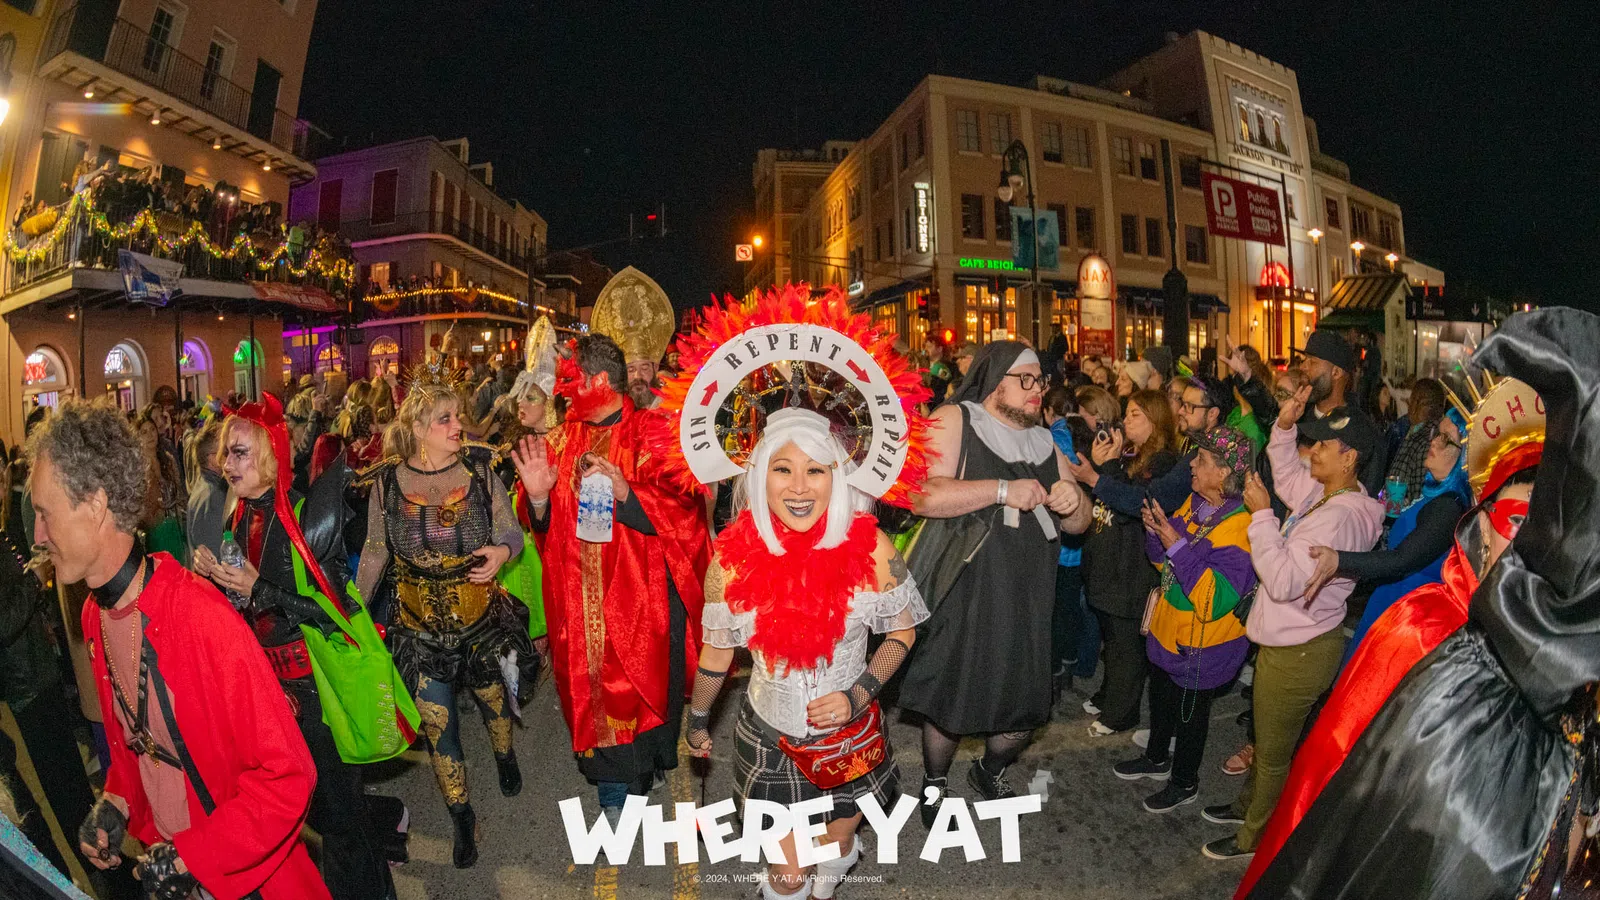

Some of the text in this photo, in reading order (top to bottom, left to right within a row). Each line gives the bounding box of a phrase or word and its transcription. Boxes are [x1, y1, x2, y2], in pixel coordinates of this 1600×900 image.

[1233, 144, 1265, 162] JACKSON
[1247, 189, 1269, 205] Public
[1249, 202, 1277, 220] Parking
[918, 189, 928, 252] BEIGNET
[959, 257, 1028, 271] CAFE BEIG
[1082, 268, 1109, 283] JAX
[724, 332, 841, 370] REPENT
[690, 415, 711, 451] SIN
[872, 394, 900, 482] REPEAT
